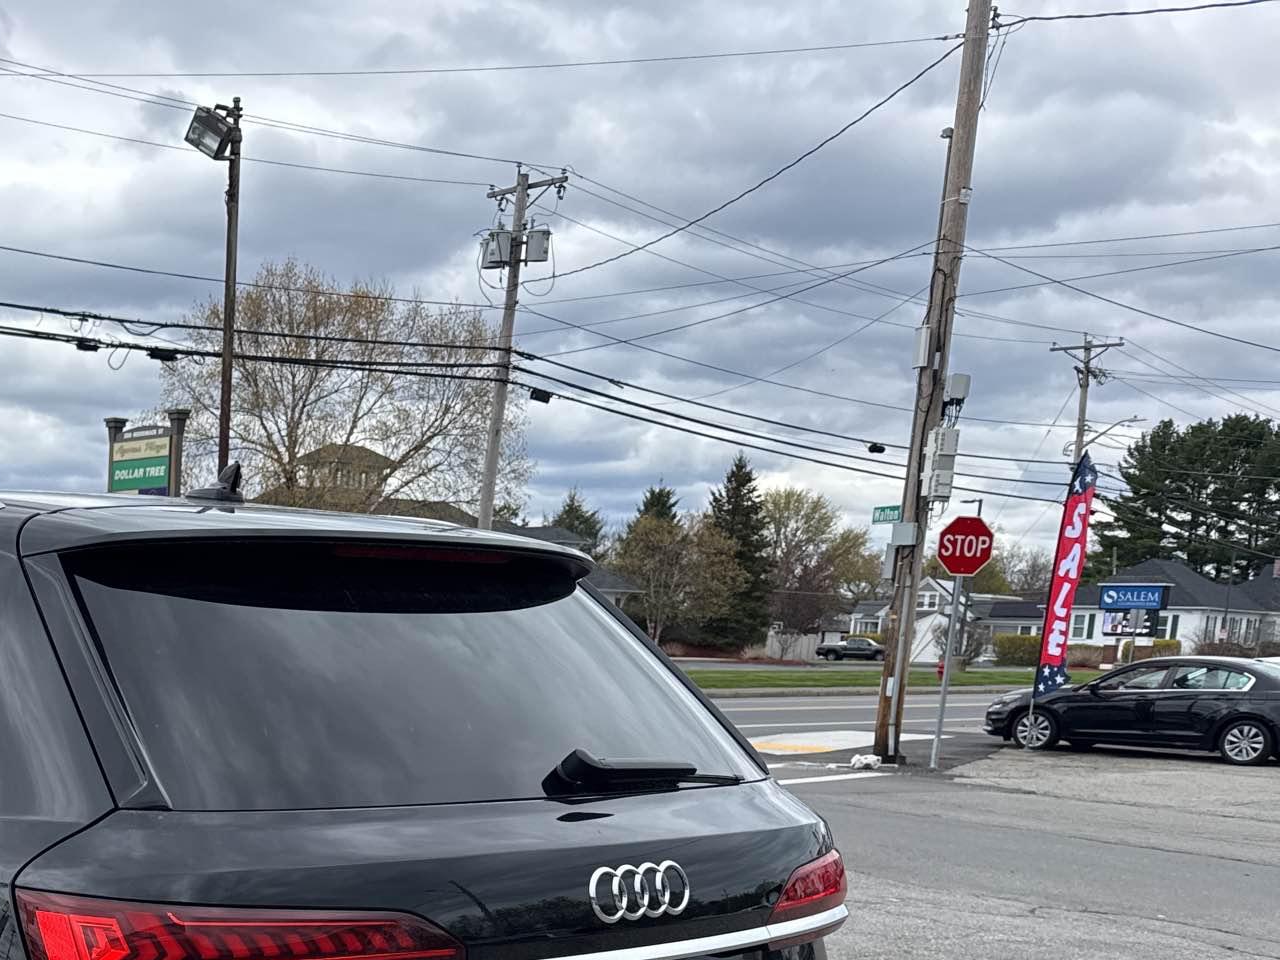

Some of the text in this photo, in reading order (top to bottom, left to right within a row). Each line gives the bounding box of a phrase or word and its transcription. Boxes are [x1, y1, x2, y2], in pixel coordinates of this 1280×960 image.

[114, 466, 166, 480] DOLLAR TREE
[941, 534, 990, 557] STOP
[1047, 503, 1086, 656] SALE
[1117, 591, 1159, 602] SALEM
